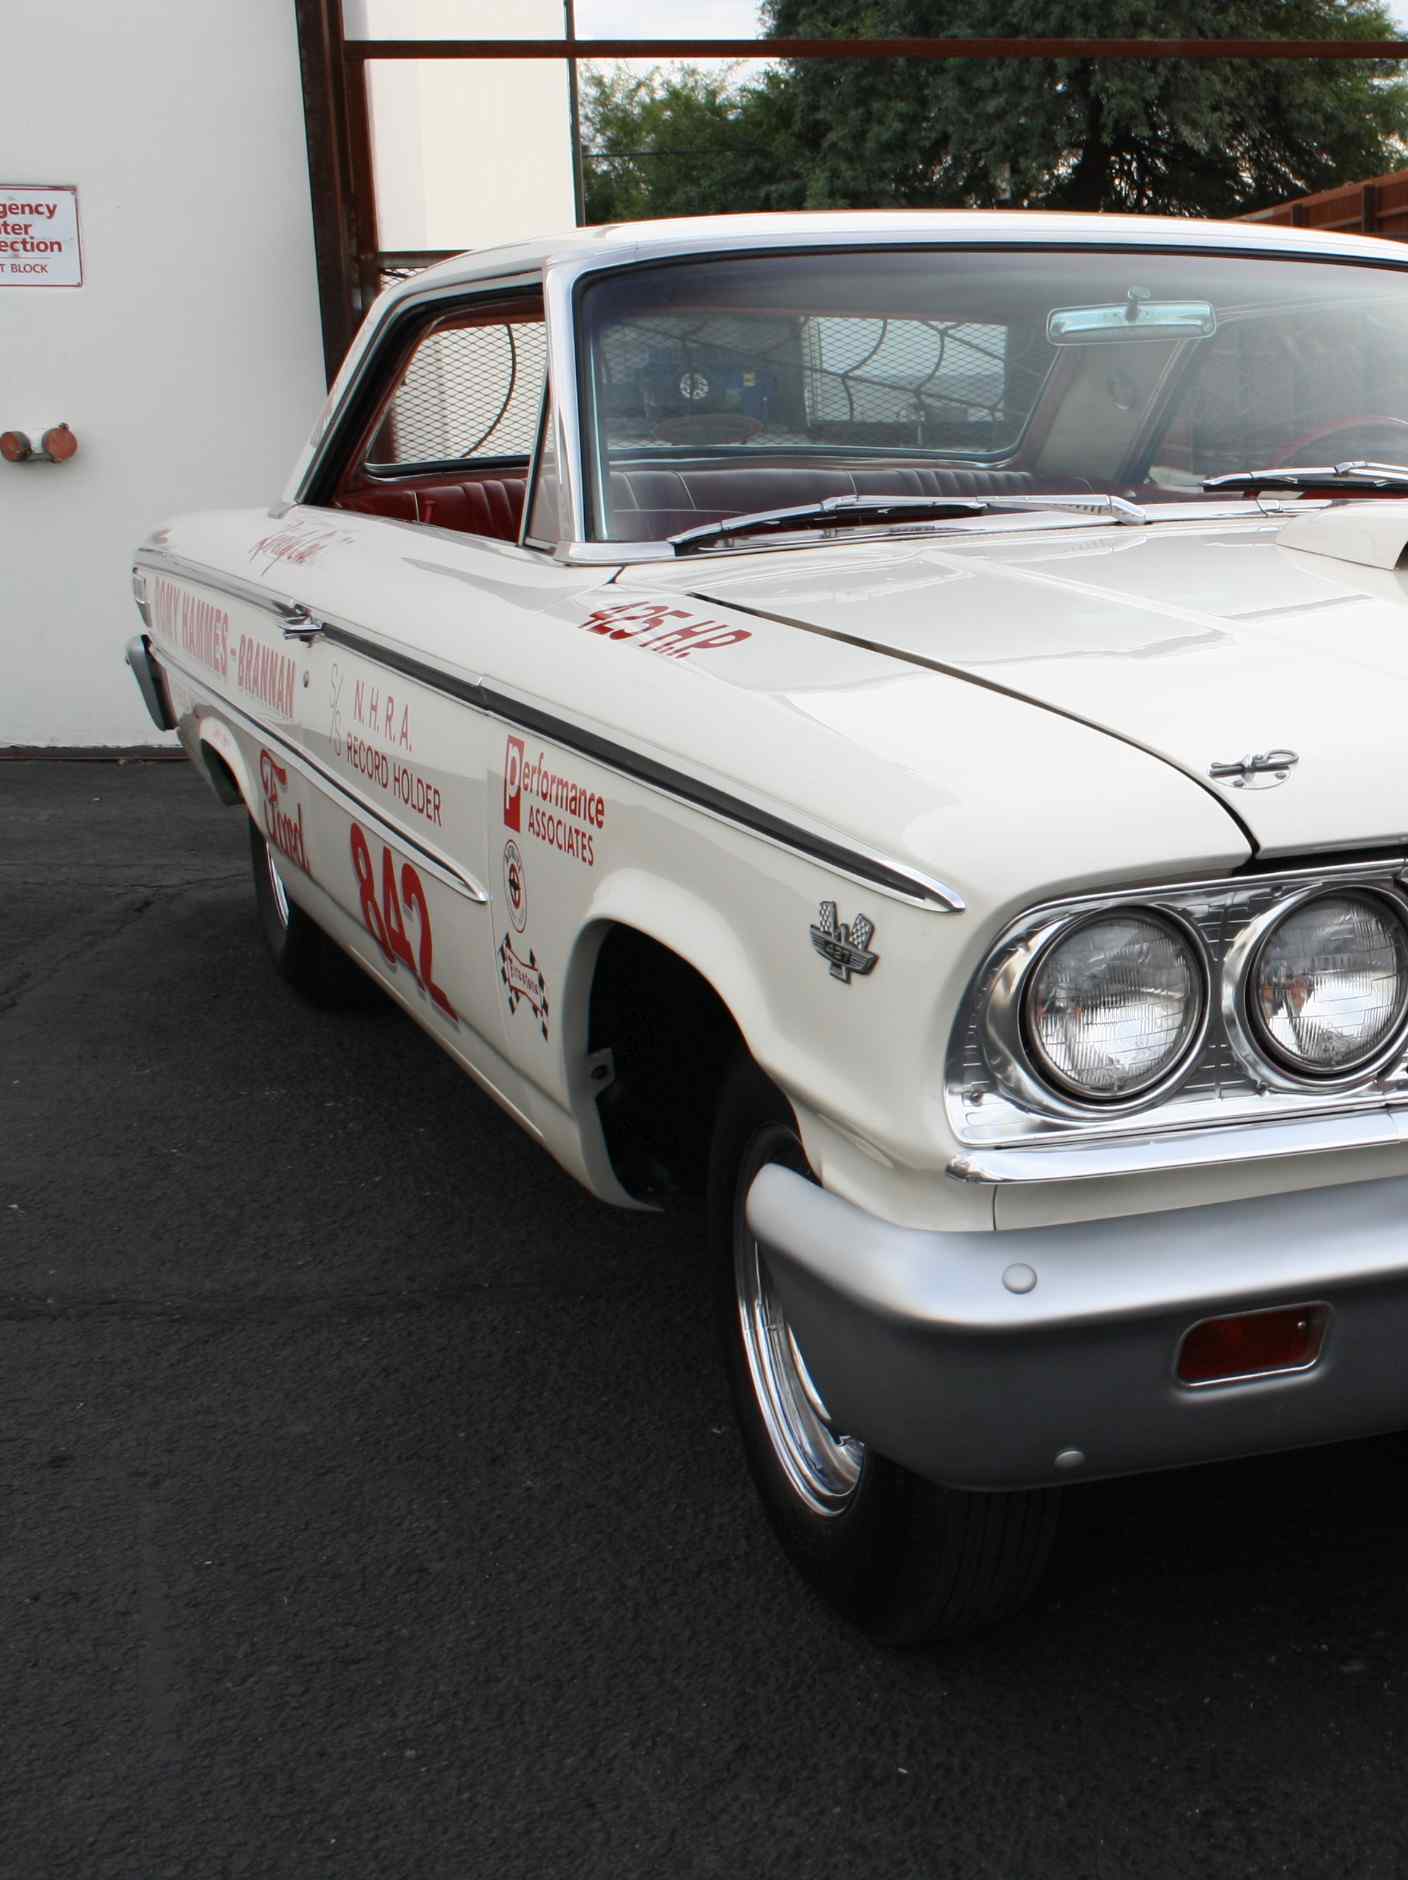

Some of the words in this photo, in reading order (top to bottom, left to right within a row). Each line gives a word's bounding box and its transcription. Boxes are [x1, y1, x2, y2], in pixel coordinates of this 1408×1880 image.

[0, 221, 32, 235] ter
[10, 263, 48, 273] BLOCK
[577, 601, 695, 640] 425
[346, 732, 389, 789] RECORD
[393, 762, 441, 827] HOLDER
[527, 805, 594, 866] ASSOCIATES
[350, 822, 461, 1023] 842
